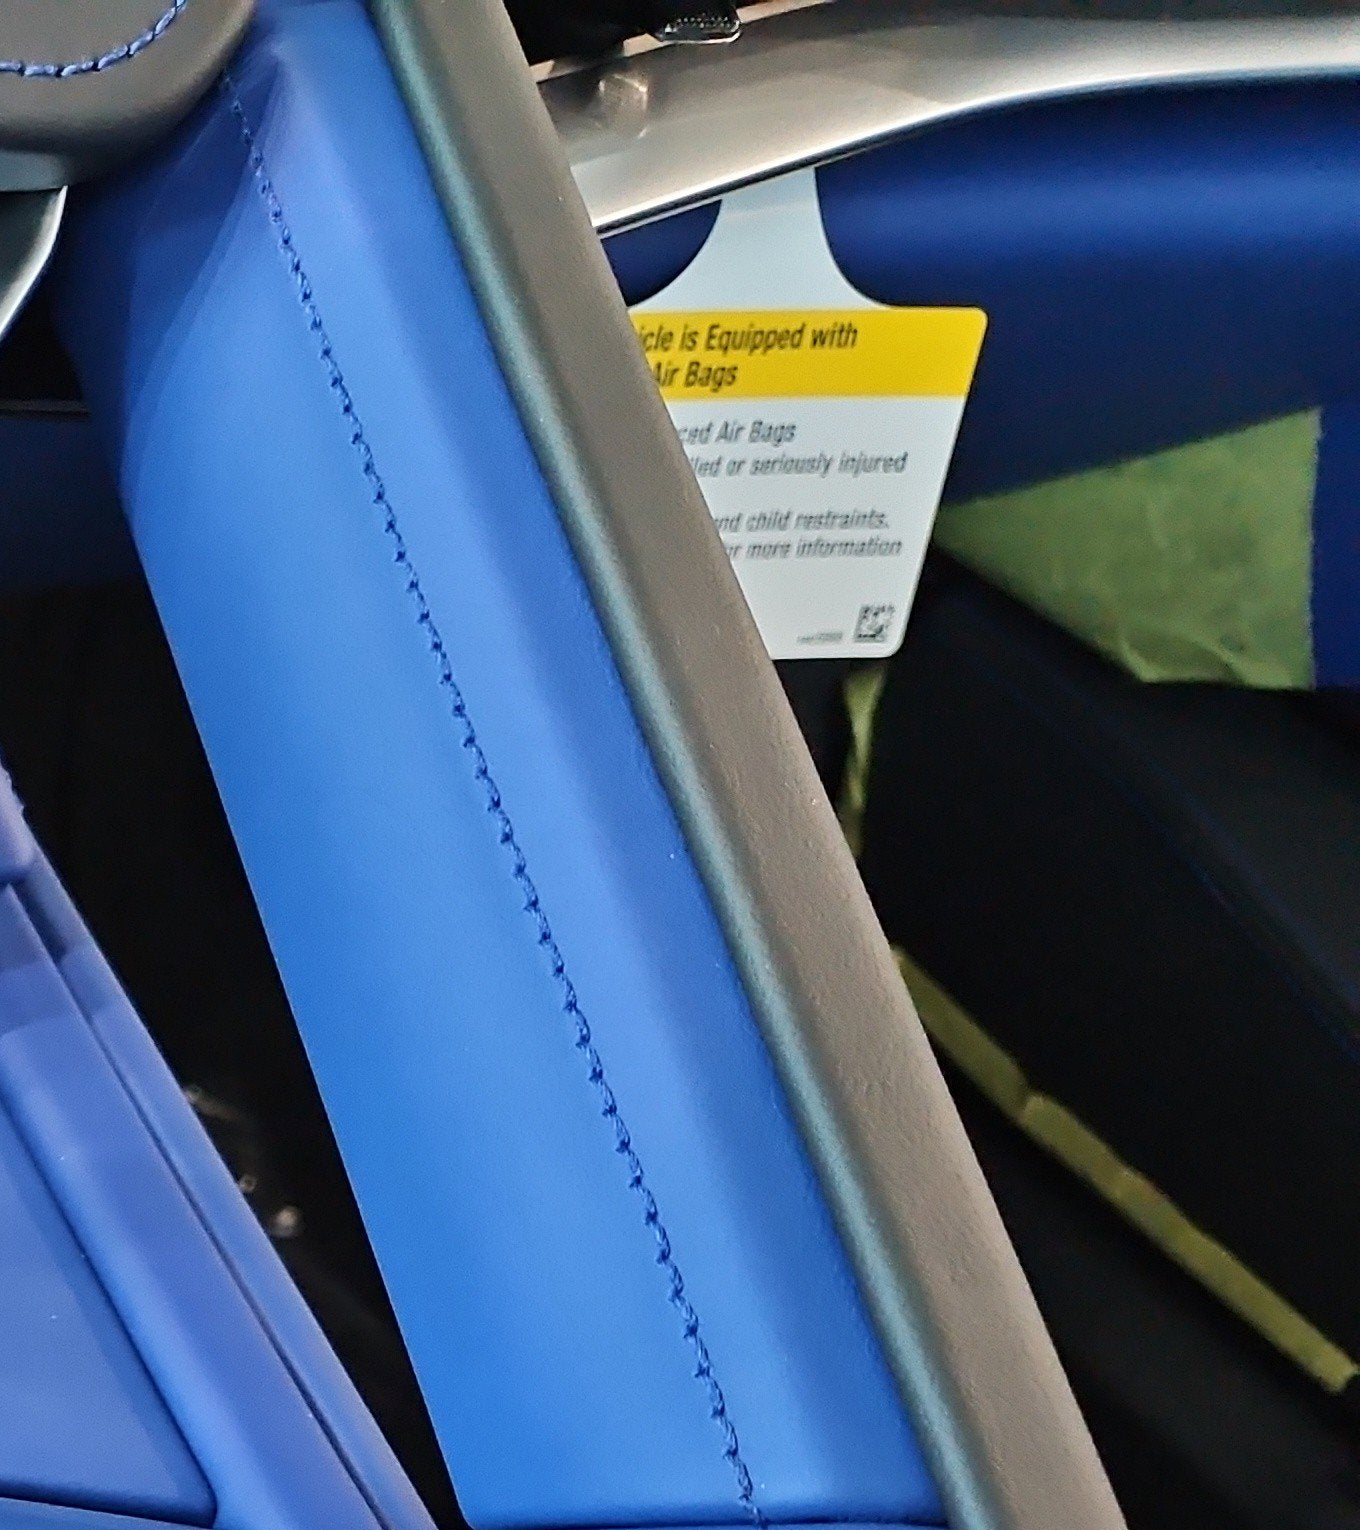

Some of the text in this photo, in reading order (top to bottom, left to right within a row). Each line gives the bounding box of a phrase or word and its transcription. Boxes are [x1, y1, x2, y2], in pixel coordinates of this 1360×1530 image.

[679, 324, 698, 351] is
[705, 323, 806, 355] Equipped
[811, 322, 858, 349] with
[684, 361, 738, 392] Bags
[715, 420, 745, 442] Air
[747, 420, 796, 447] Bags
[726, 459, 746, 476] or
[750, 452, 833, 478] seriously
[838, 451, 908, 478] injured
[746, 510, 791, 532] child
[746, 544, 790, 559] more
[795, 534, 902, 558] information
